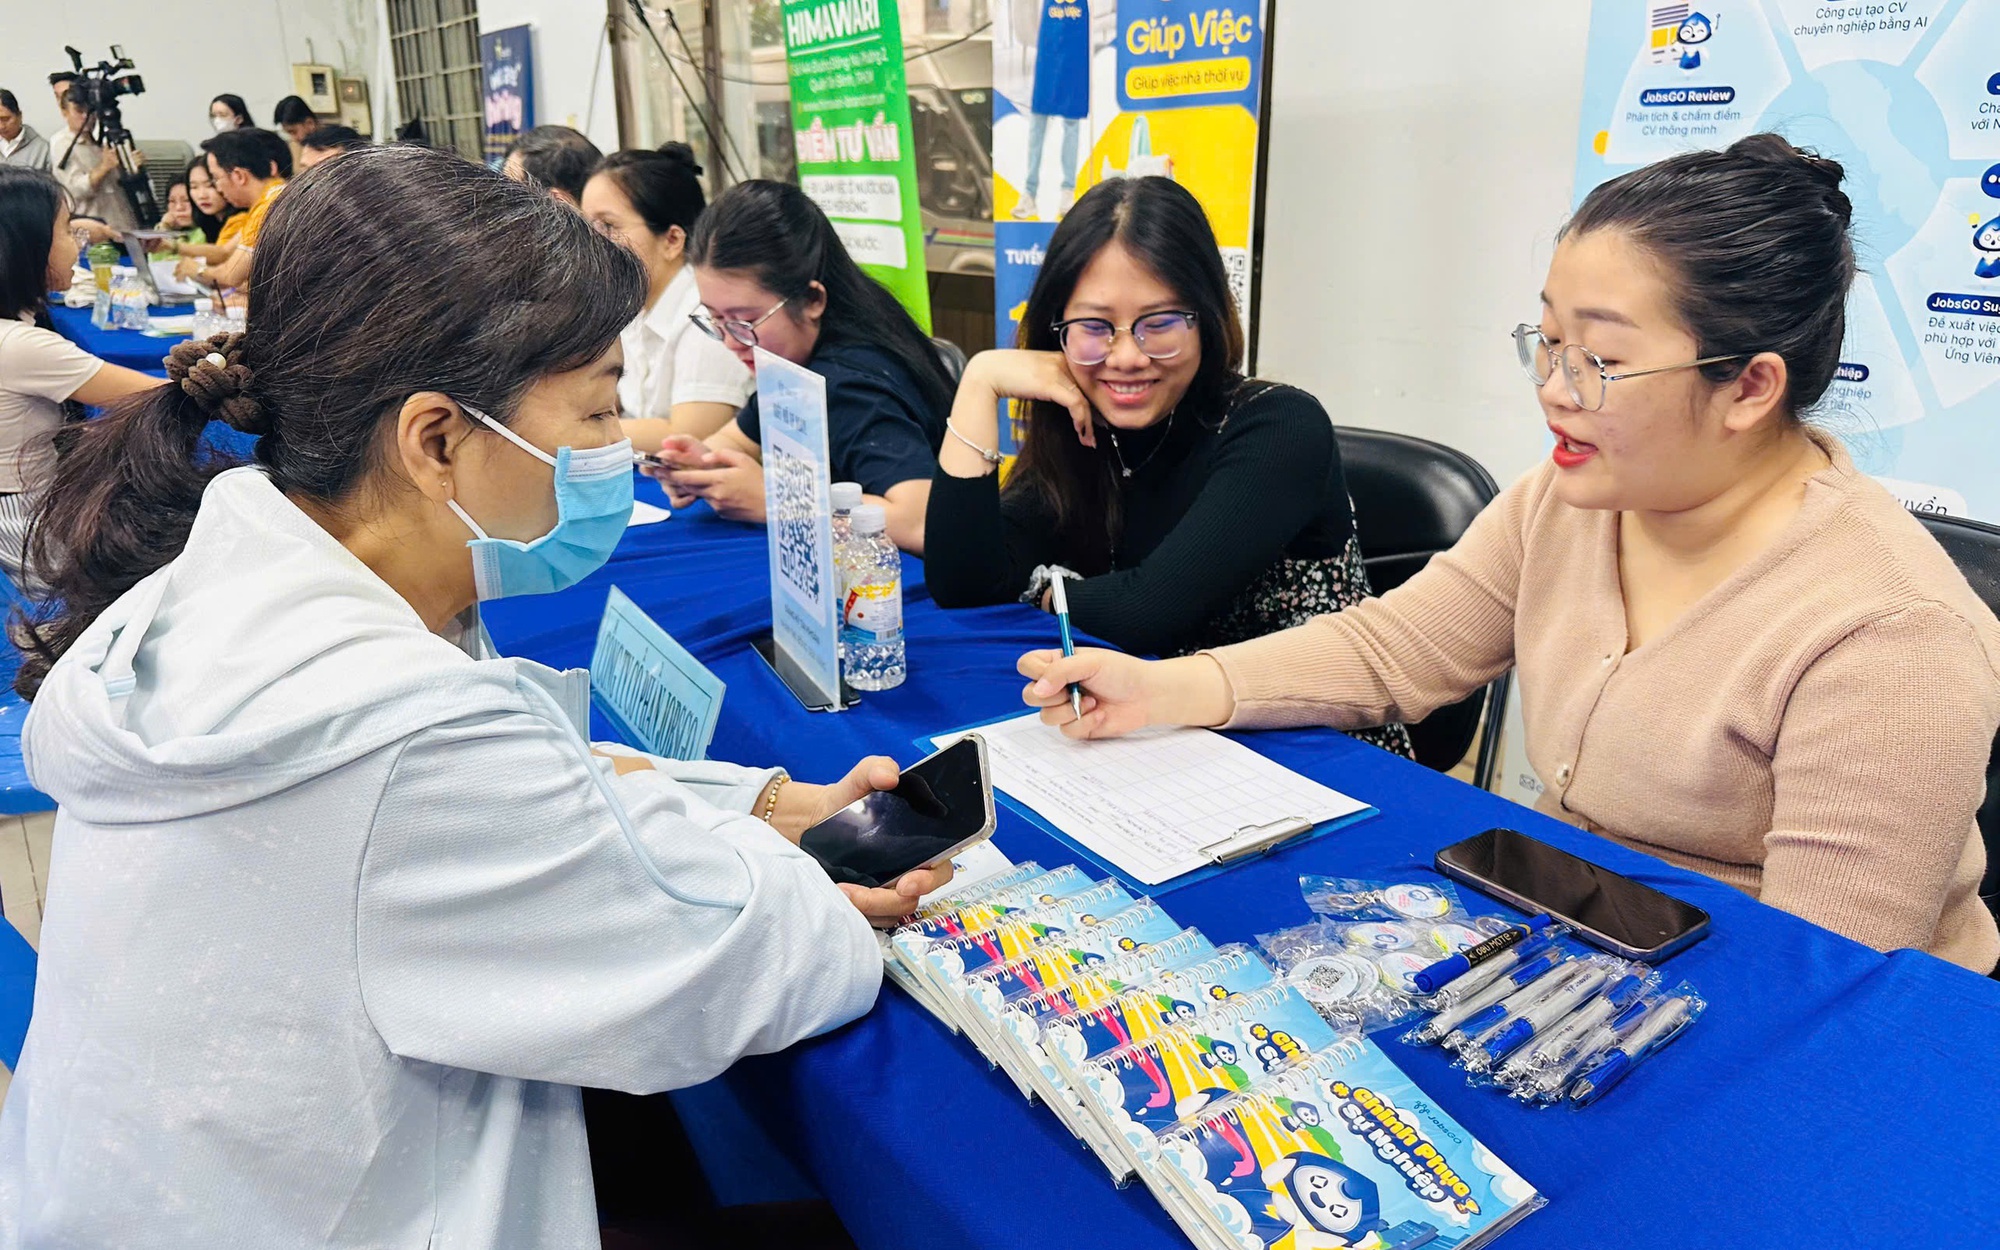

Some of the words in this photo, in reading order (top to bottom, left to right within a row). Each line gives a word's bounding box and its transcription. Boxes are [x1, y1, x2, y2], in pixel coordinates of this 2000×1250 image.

[1815, 8, 1845, 19] Công
[1848, 7, 1862, 18] cụ
[1865, 5, 1884, 17] tạo
[1888, 2, 1908, 13] CV
[786, 0, 880, 47] HIMAWARI
[1794, 23, 1834, 37] chuyên
[1836, 19, 1876, 35] nghiệp
[1879, 15, 1911, 31] bằng
[1913, 16, 1928, 27] AI
[1126, 17, 1185, 59] Giúp
[1189, 9, 1252, 54] Việc
[1643, 91, 1687, 103] JobsGO
[1687, 89, 1731, 102] Review
[1626, 112, 1648, 122] Phân
[1652, 111, 1669, 121] tích
[1672, 111, 1679, 122] &
[1681, 109, 1711, 122] chấm
[1713, 107, 1741, 121] điểm
[1642, 125, 1657, 136] CV
[1658, 125, 1688, 137] thông
[1690, 124, 1717, 135] minh
[1971, 118, 1990, 130] với
[1932, 297, 1980, 311] JobsGO
[1928, 315, 1945, 328] Đề
[1949, 317, 1975, 331] xuất
[1924, 332, 1947, 344] phù
[1951, 334, 1974, 348] hợp
[1978, 336, 1996, 348] với
[1945, 346, 1969, 363] Ứng
[1353, 1088, 1418, 1146] Chinh
[1413, 1142, 1470, 1198] Phục
[1342, 1103, 1375, 1131] Sự
[1368, 1128, 1444, 1200] Nghiệp
